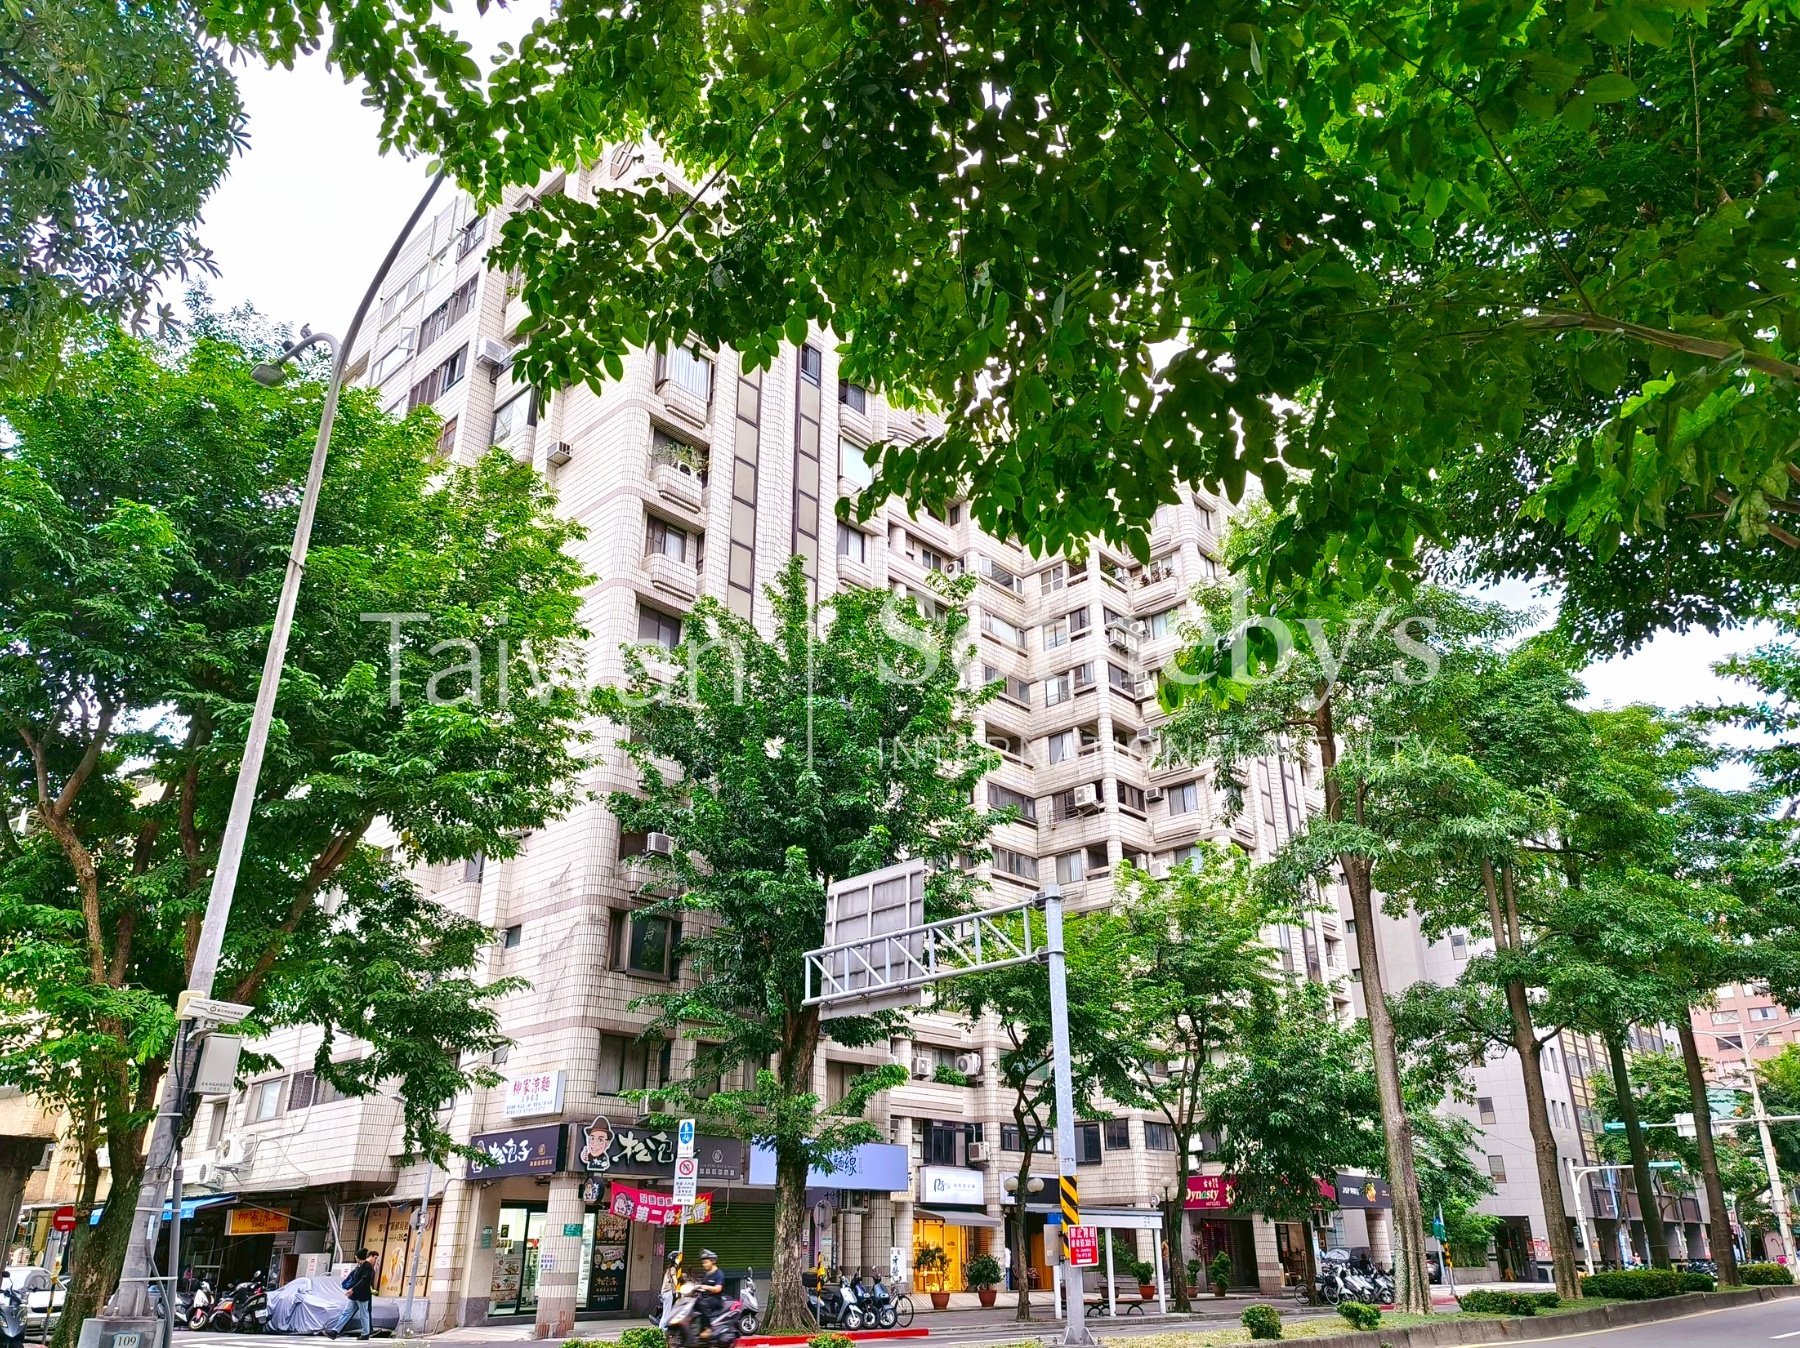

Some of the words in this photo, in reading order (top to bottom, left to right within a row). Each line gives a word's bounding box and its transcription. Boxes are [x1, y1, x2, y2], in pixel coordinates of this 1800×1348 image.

[612, 1131, 702, 1164] 松包
[1186, 1188, 1219, 1203] Dynasty
[118, 1336, 137, 1347] 109
